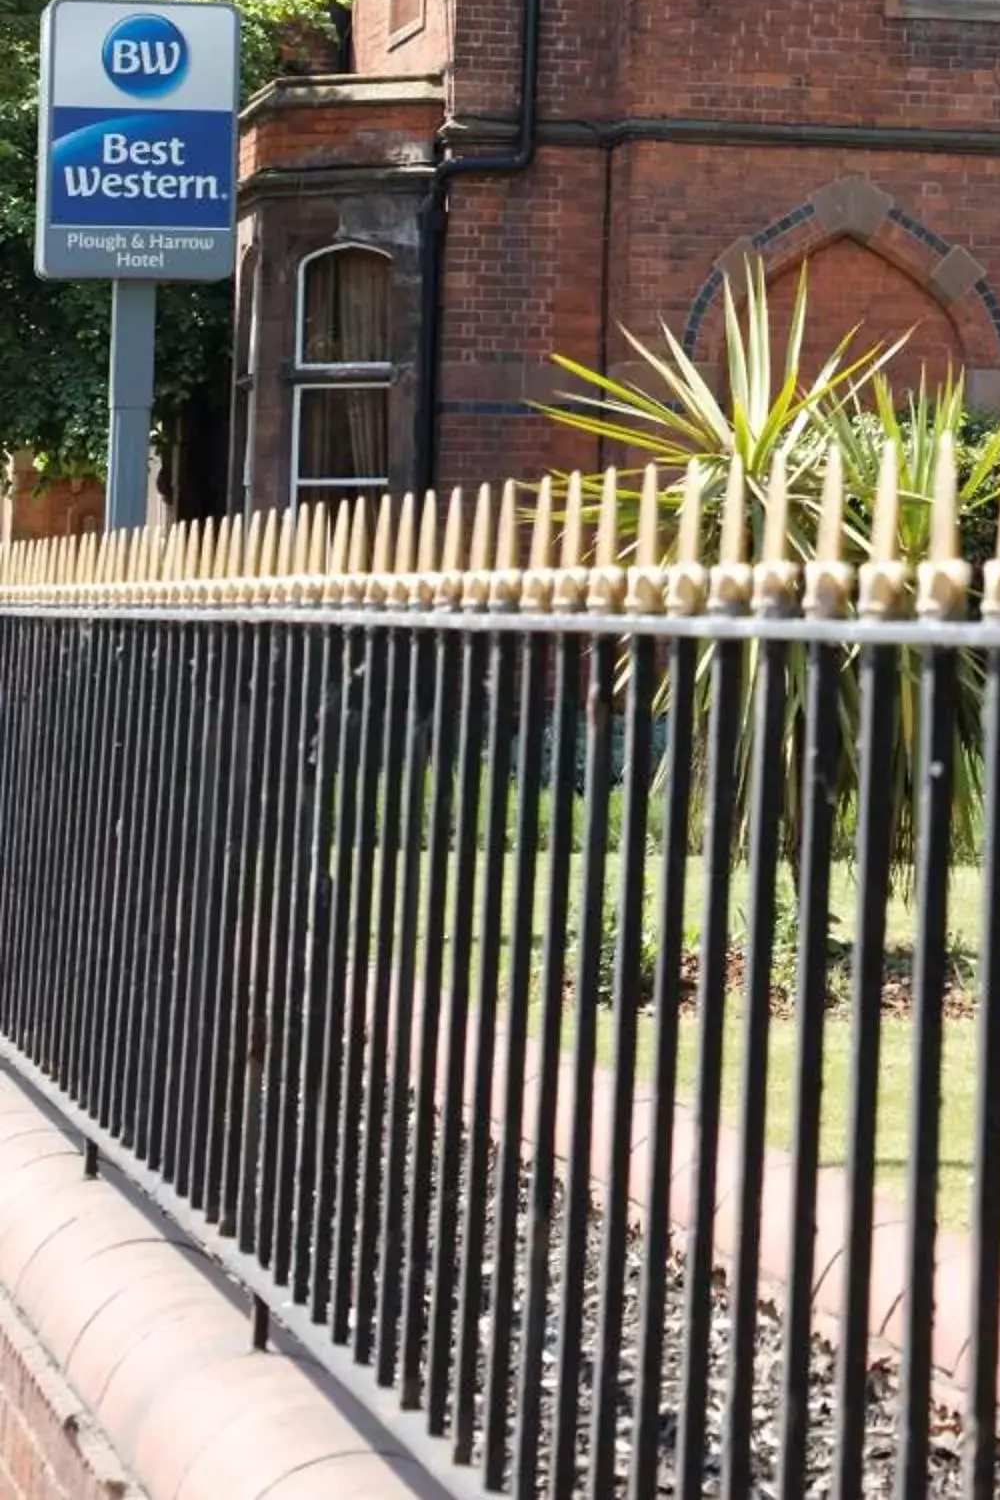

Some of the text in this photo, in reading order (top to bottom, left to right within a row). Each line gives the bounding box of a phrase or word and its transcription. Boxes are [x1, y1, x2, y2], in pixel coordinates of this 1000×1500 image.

[112, 39, 180, 76] BW
[103, 133, 185, 166] Best
[67, 232, 215, 251] Plough & Harrow
[116, 251, 165, 268] Hotel
